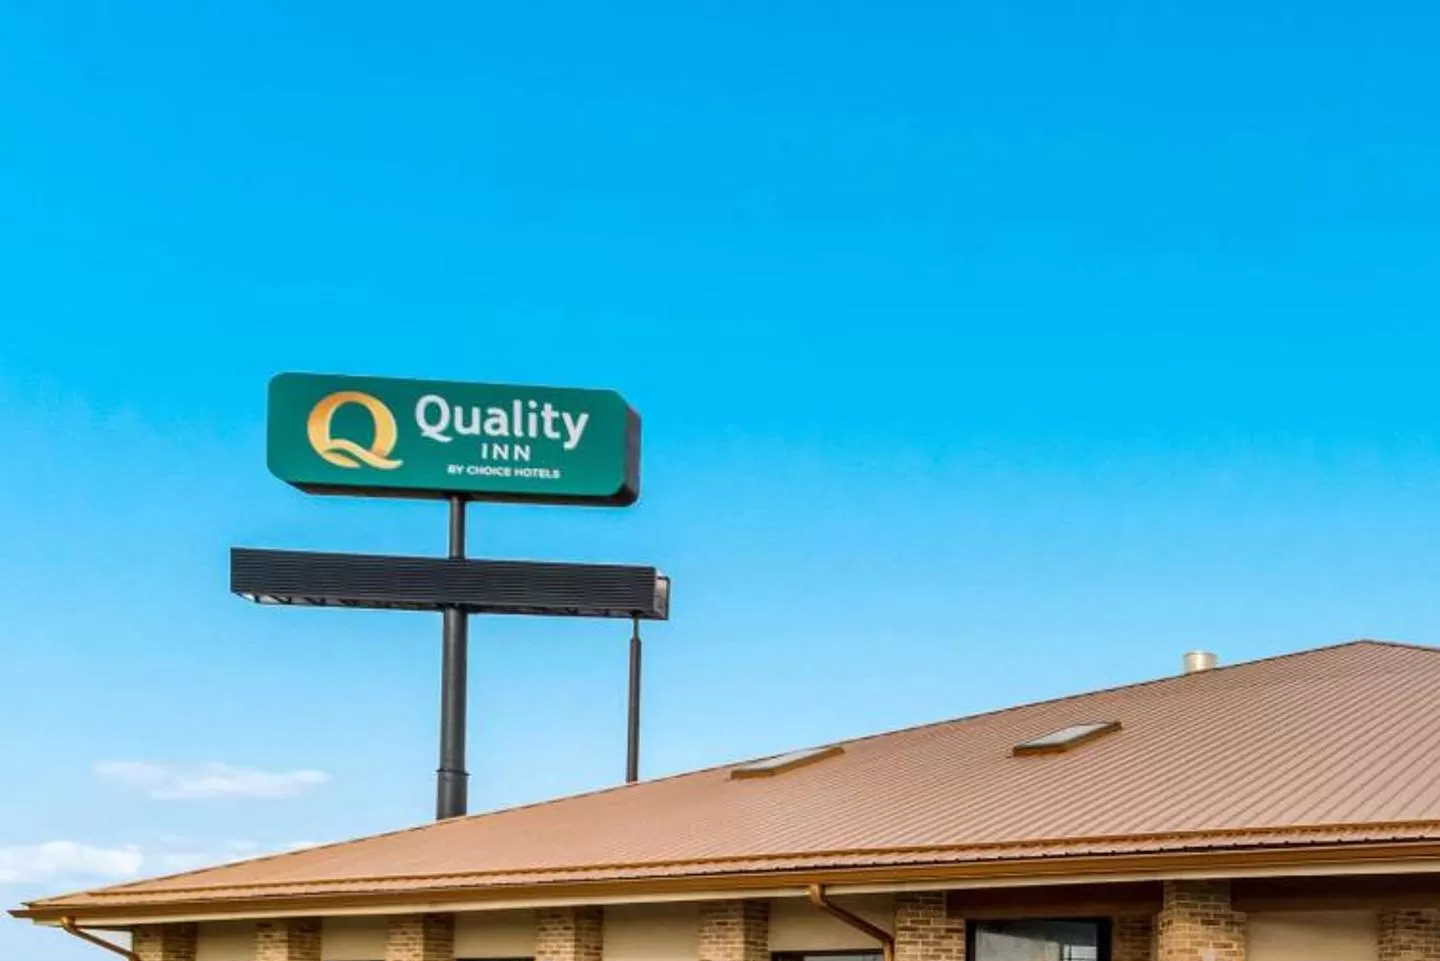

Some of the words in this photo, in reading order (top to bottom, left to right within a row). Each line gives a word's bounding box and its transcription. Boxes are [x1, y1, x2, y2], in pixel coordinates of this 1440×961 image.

[307, 391, 403, 469] Q
[415, 394, 590, 450] Quality
[481, 443, 531, 462] INN
[447, 464, 464, 475] BY
[466, 465, 512, 477] CHOICE
[514, 467, 561, 479] HOTELS
